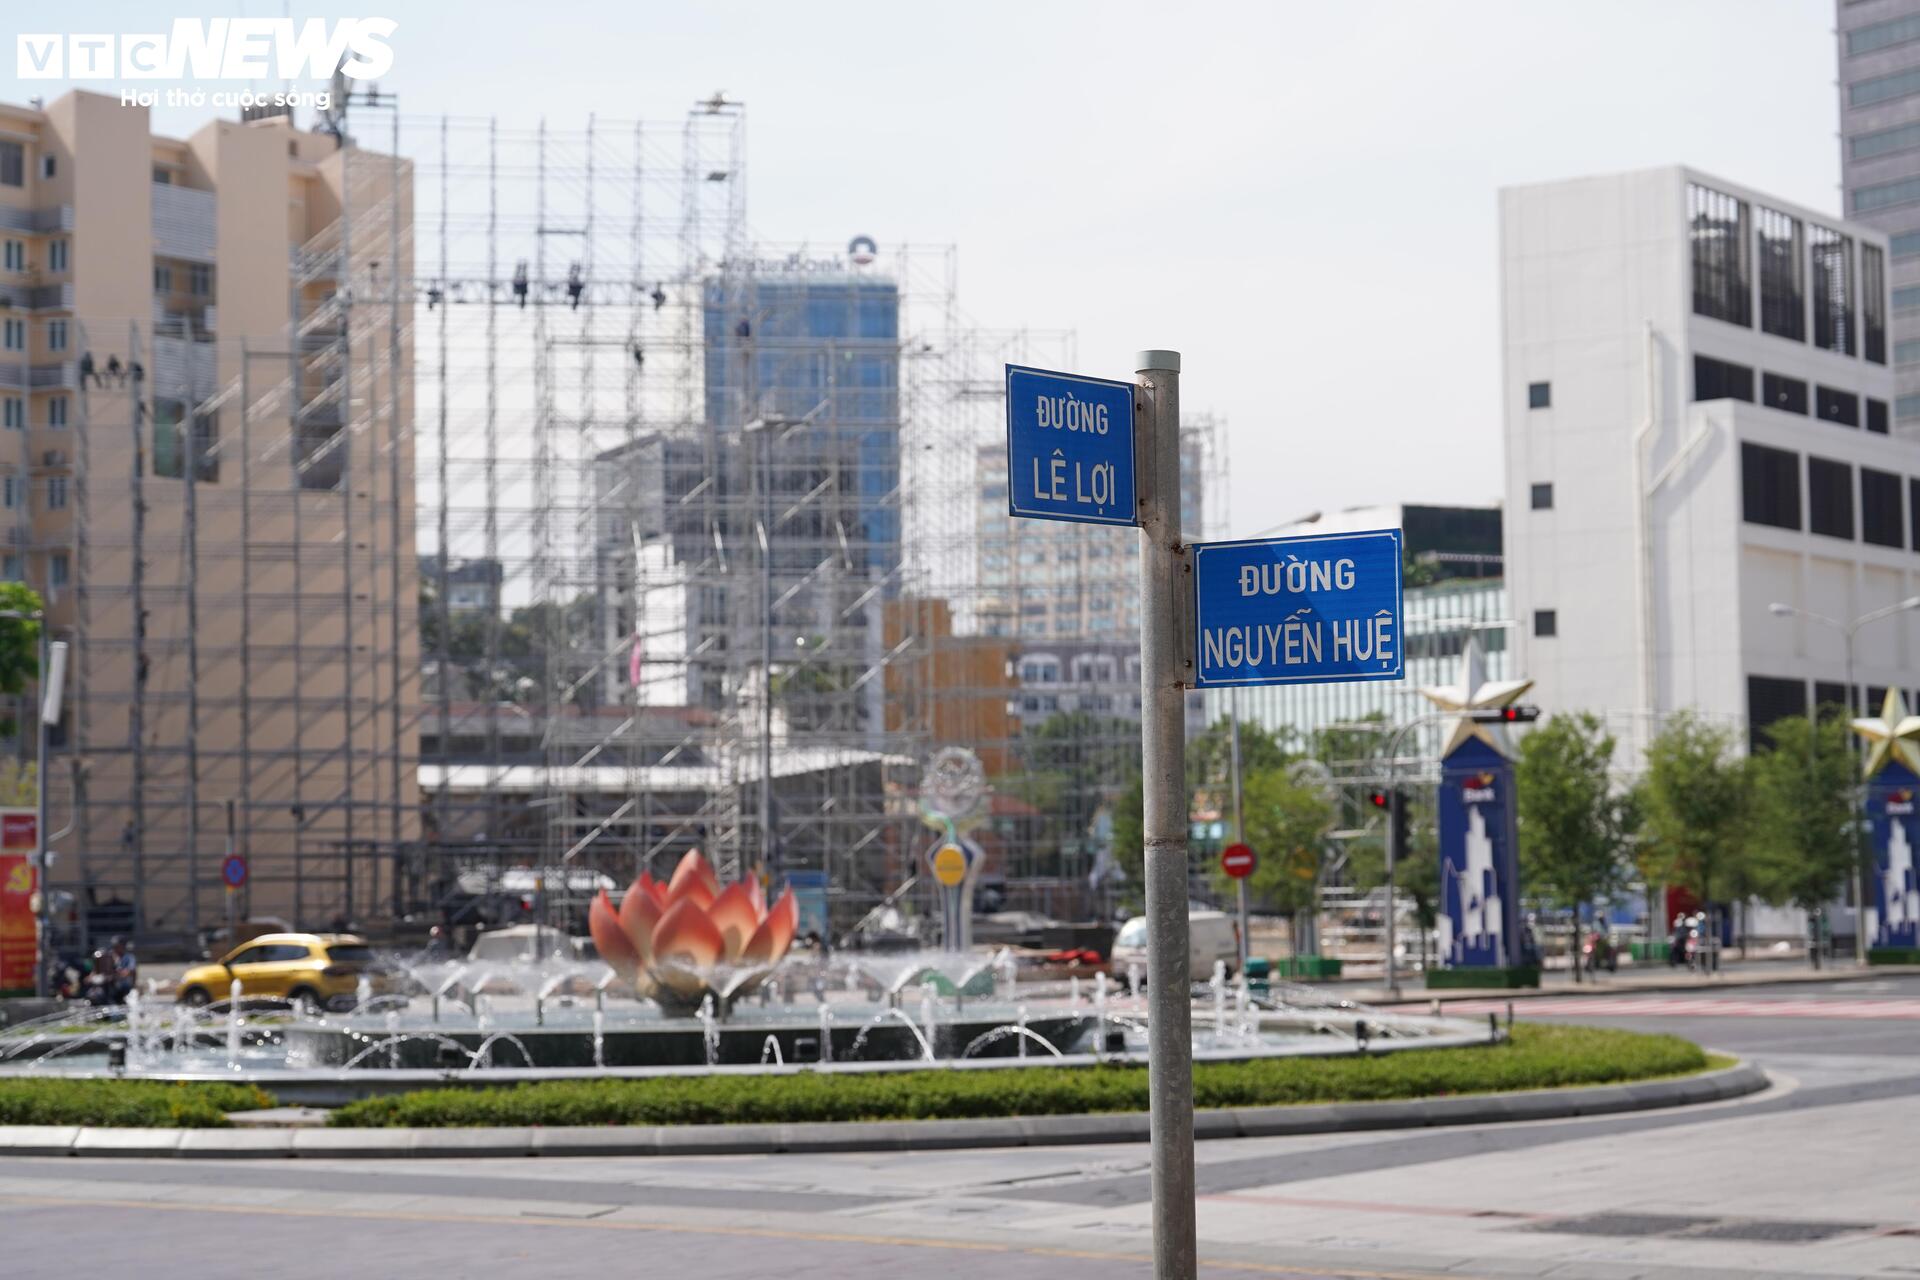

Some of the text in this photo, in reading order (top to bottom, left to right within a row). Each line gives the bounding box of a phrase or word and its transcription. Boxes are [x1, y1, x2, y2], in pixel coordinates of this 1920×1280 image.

[1036, 391, 1109, 435] ĐƯỜNG
[1033, 448, 1116, 515] LÊ LỢI
[1238, 554, 1356, 597] ĐƯỜNG
[1204, 607, 1394, 669] NGUYỄN HUỆ
